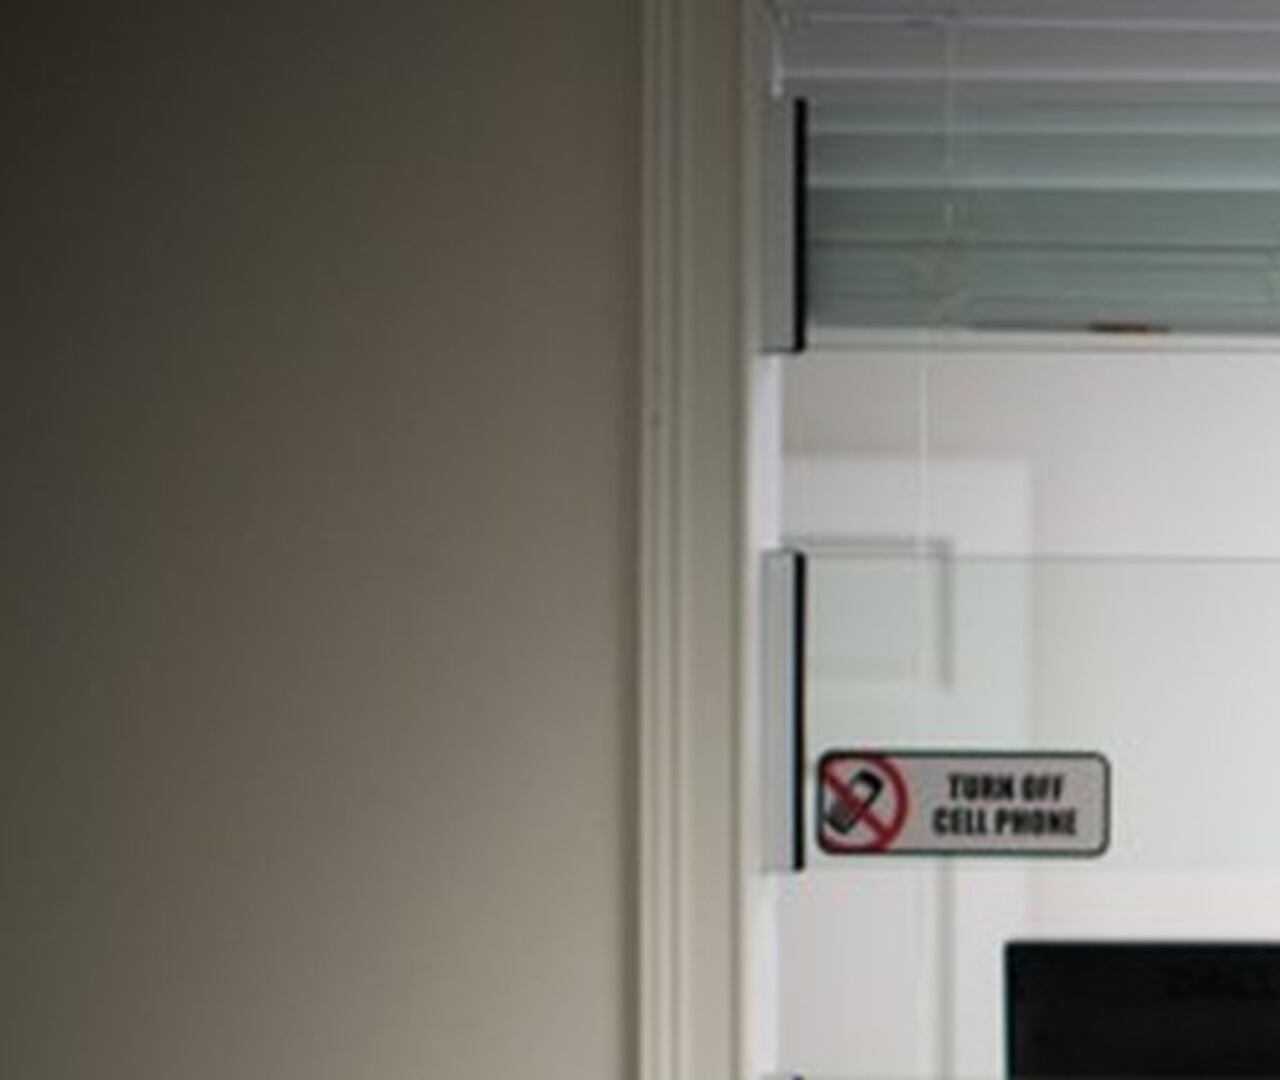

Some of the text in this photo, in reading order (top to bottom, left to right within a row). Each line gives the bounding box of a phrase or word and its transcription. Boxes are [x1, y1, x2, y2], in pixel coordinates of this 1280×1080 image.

[948, 772, 1064, 801] TURN OFF
[932, 807, 1077, 837] CELL PHONE
